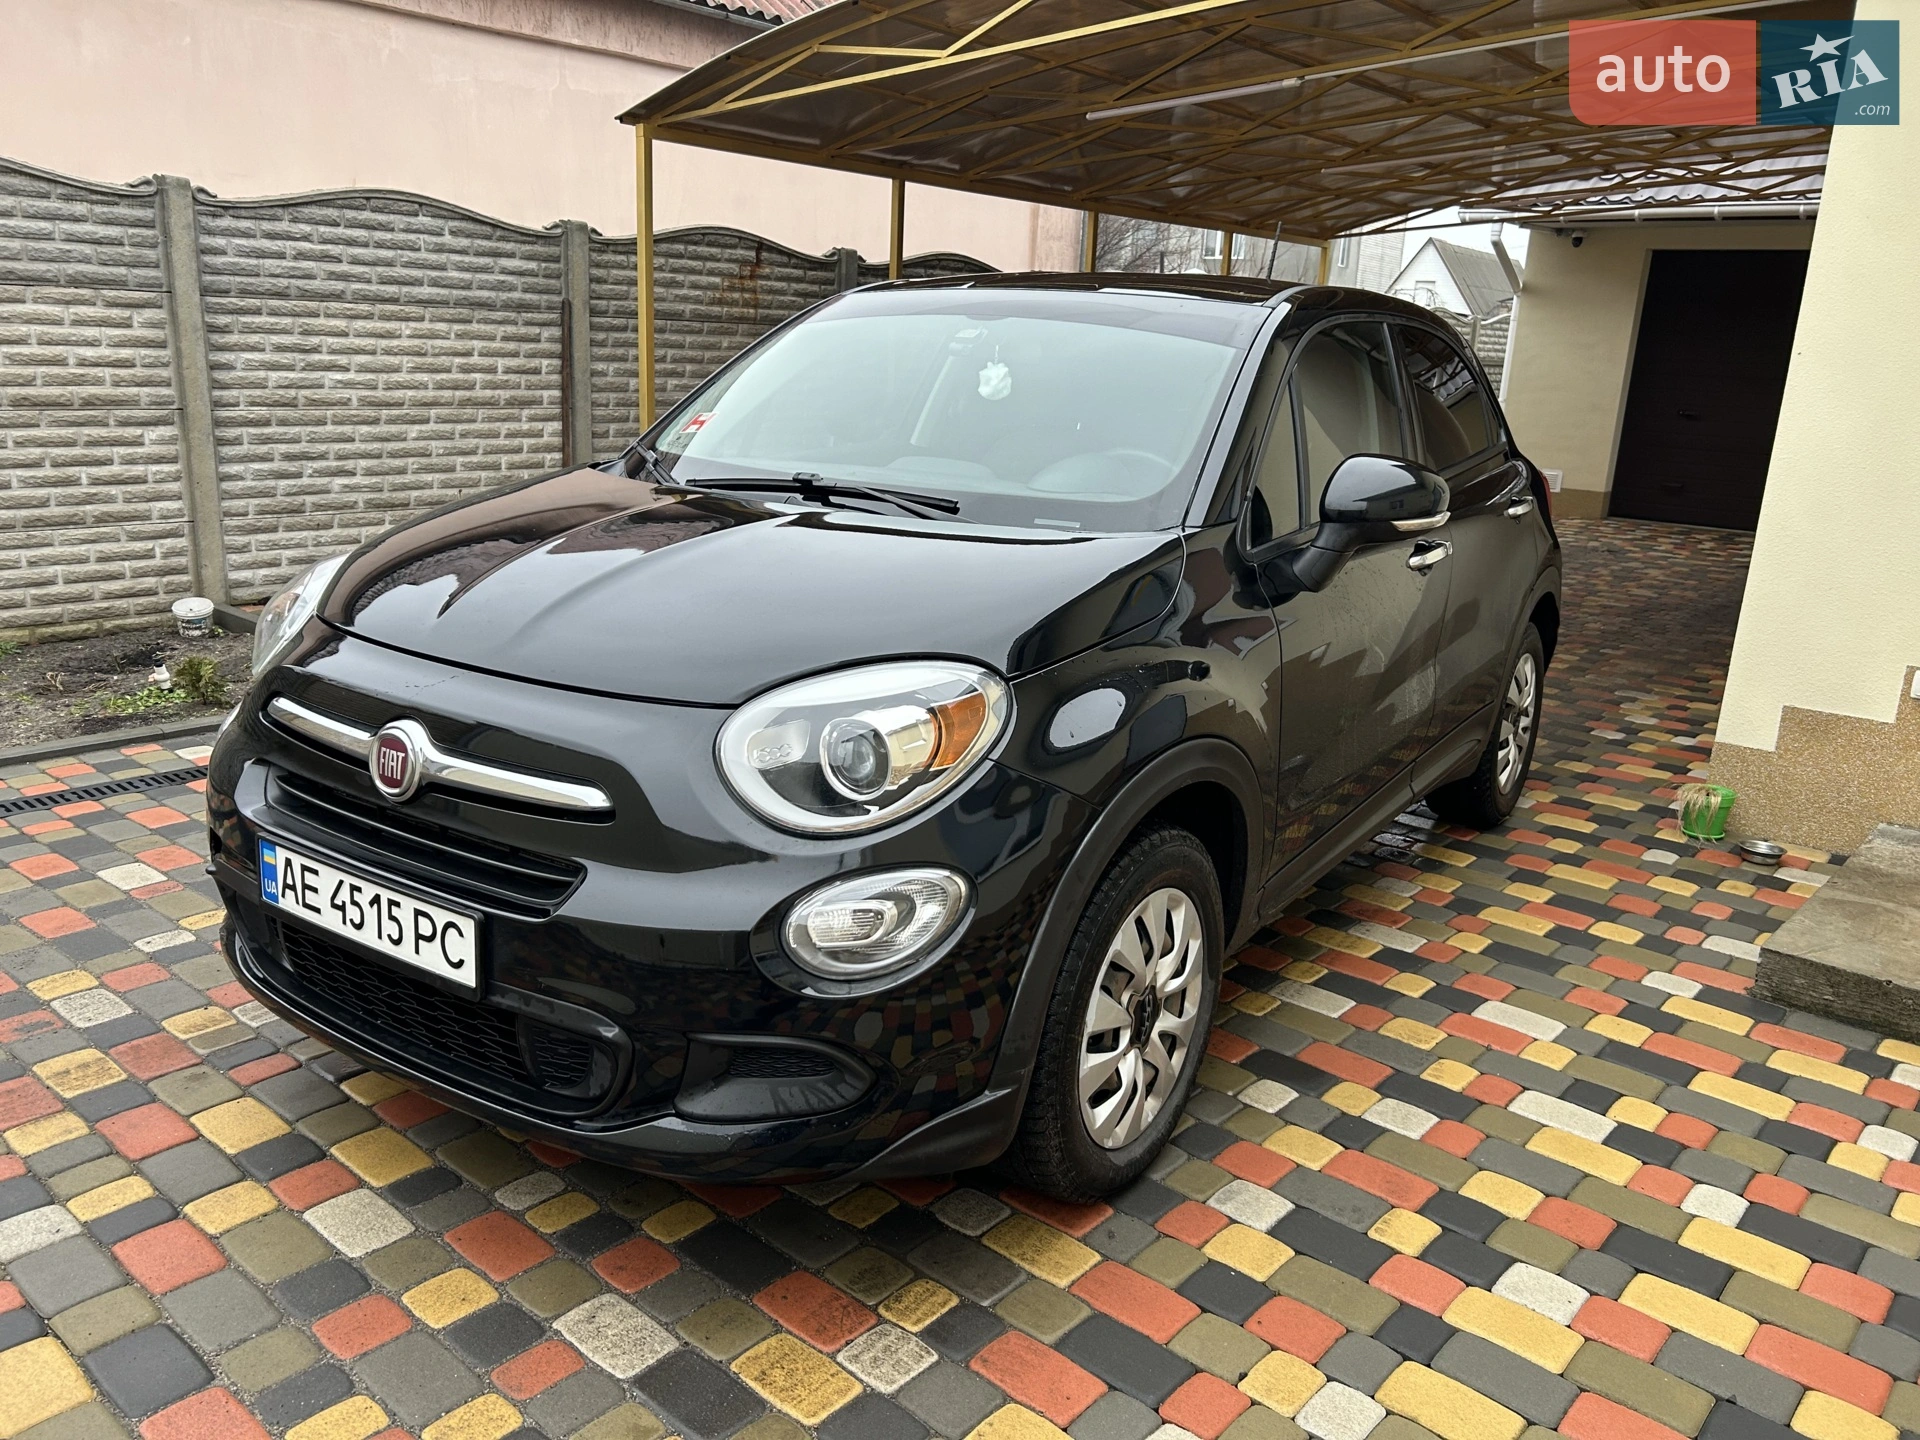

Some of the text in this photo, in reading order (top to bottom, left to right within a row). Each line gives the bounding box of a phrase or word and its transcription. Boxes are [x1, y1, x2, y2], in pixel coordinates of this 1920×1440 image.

[379, 746, 405, 780] FIAT
[264, 877, 278, 895] UA
[281, 857, 466, 970] AE 4515 PC
